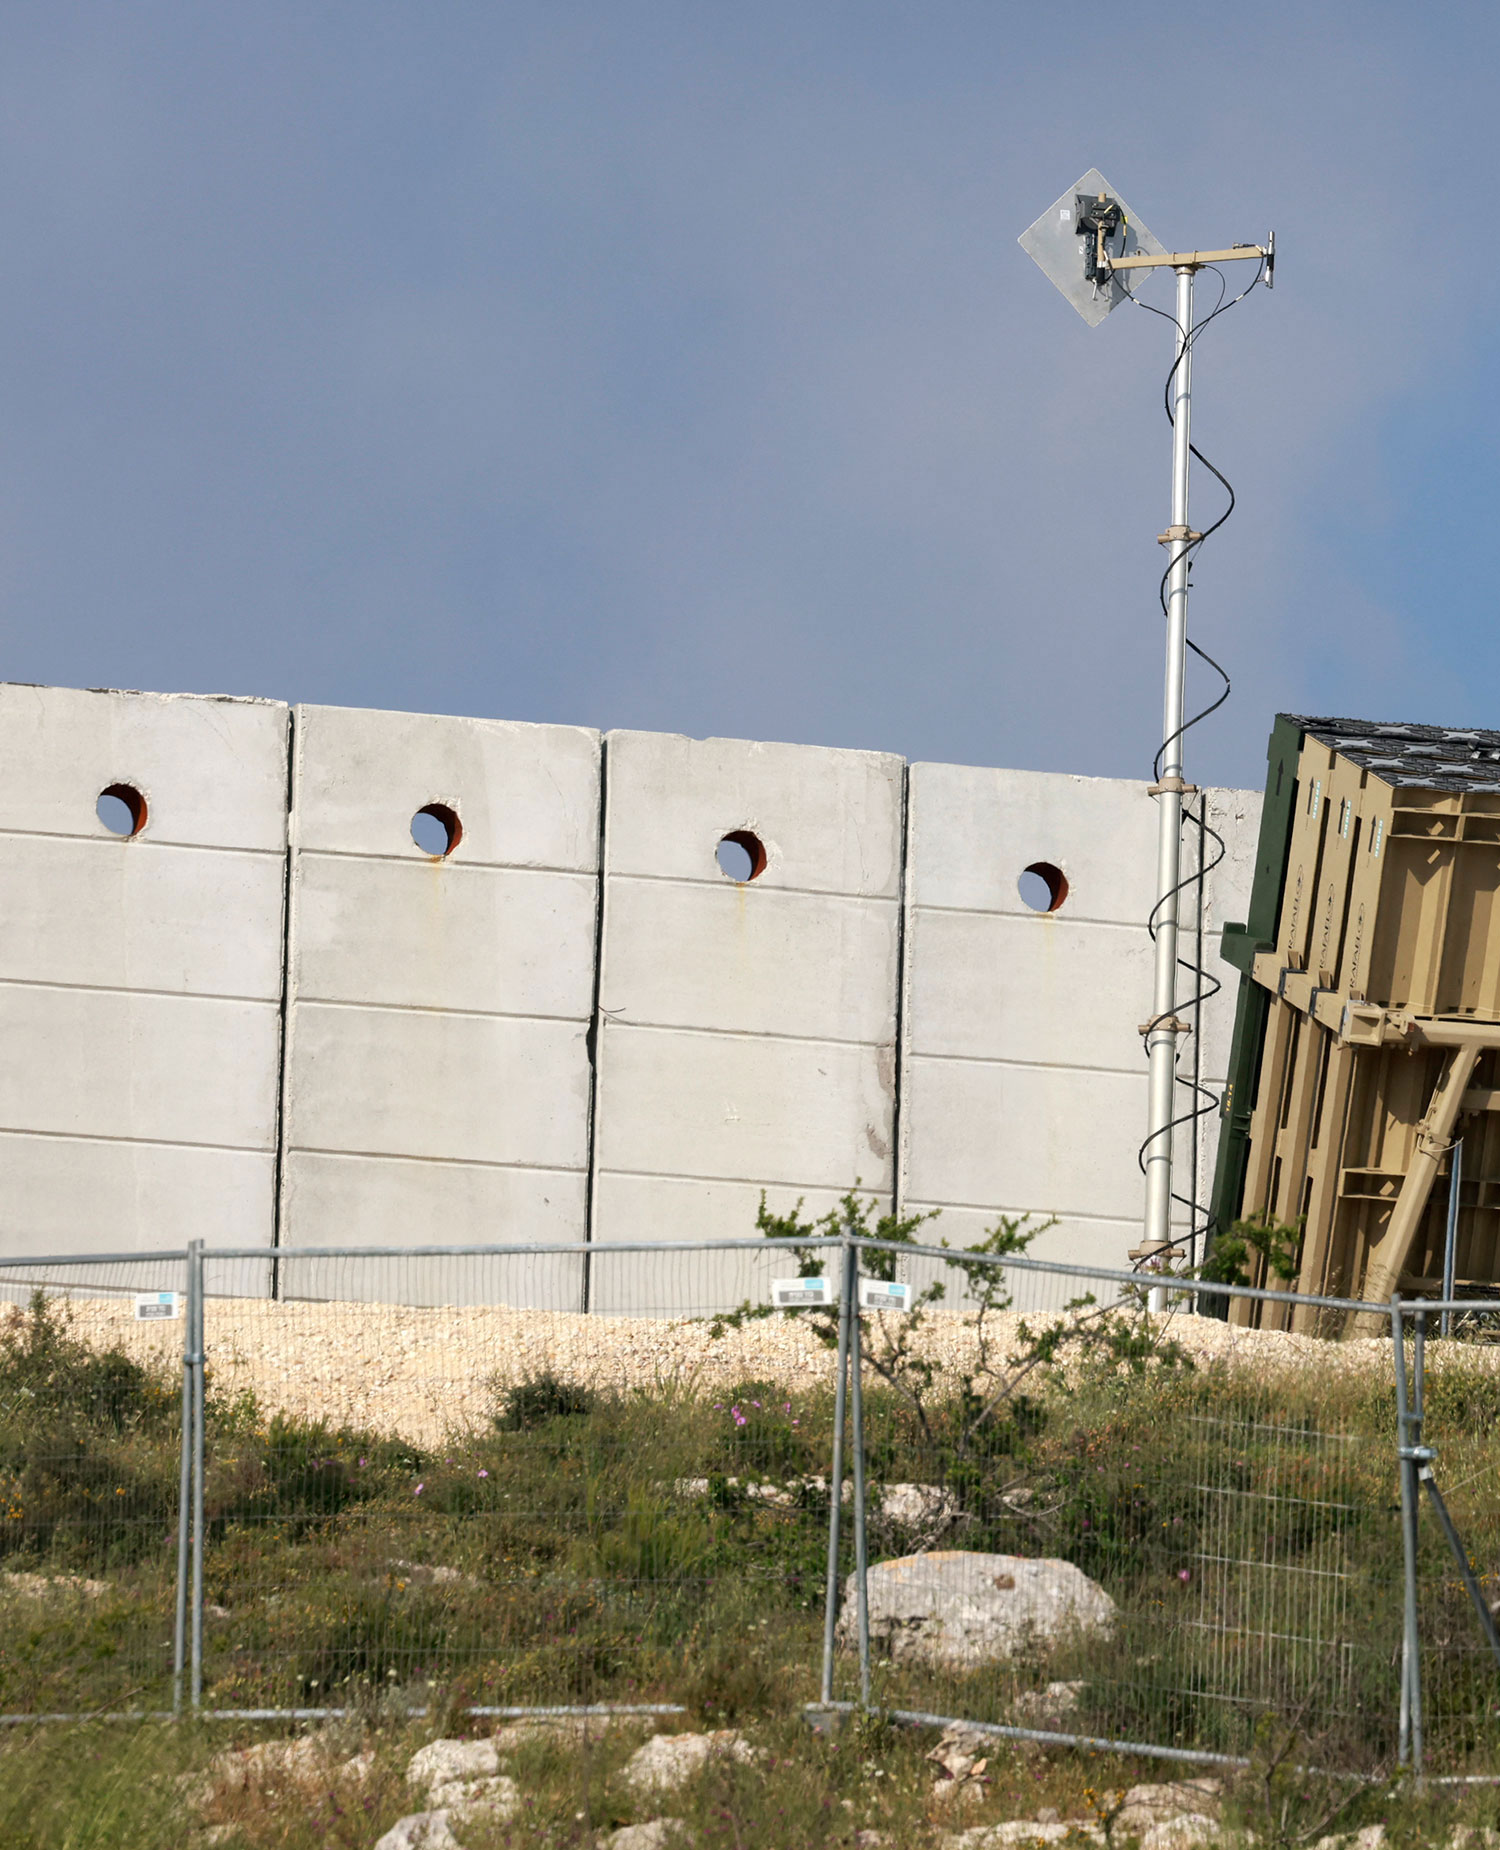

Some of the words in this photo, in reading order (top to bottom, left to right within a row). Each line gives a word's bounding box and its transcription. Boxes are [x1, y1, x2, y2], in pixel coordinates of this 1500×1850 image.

[1288, 896, 1300, 949] RAFAEL
[1319, 916, 1331, 968] RAFAEL
[1350, 936, 1361, 988] RAFAEL
